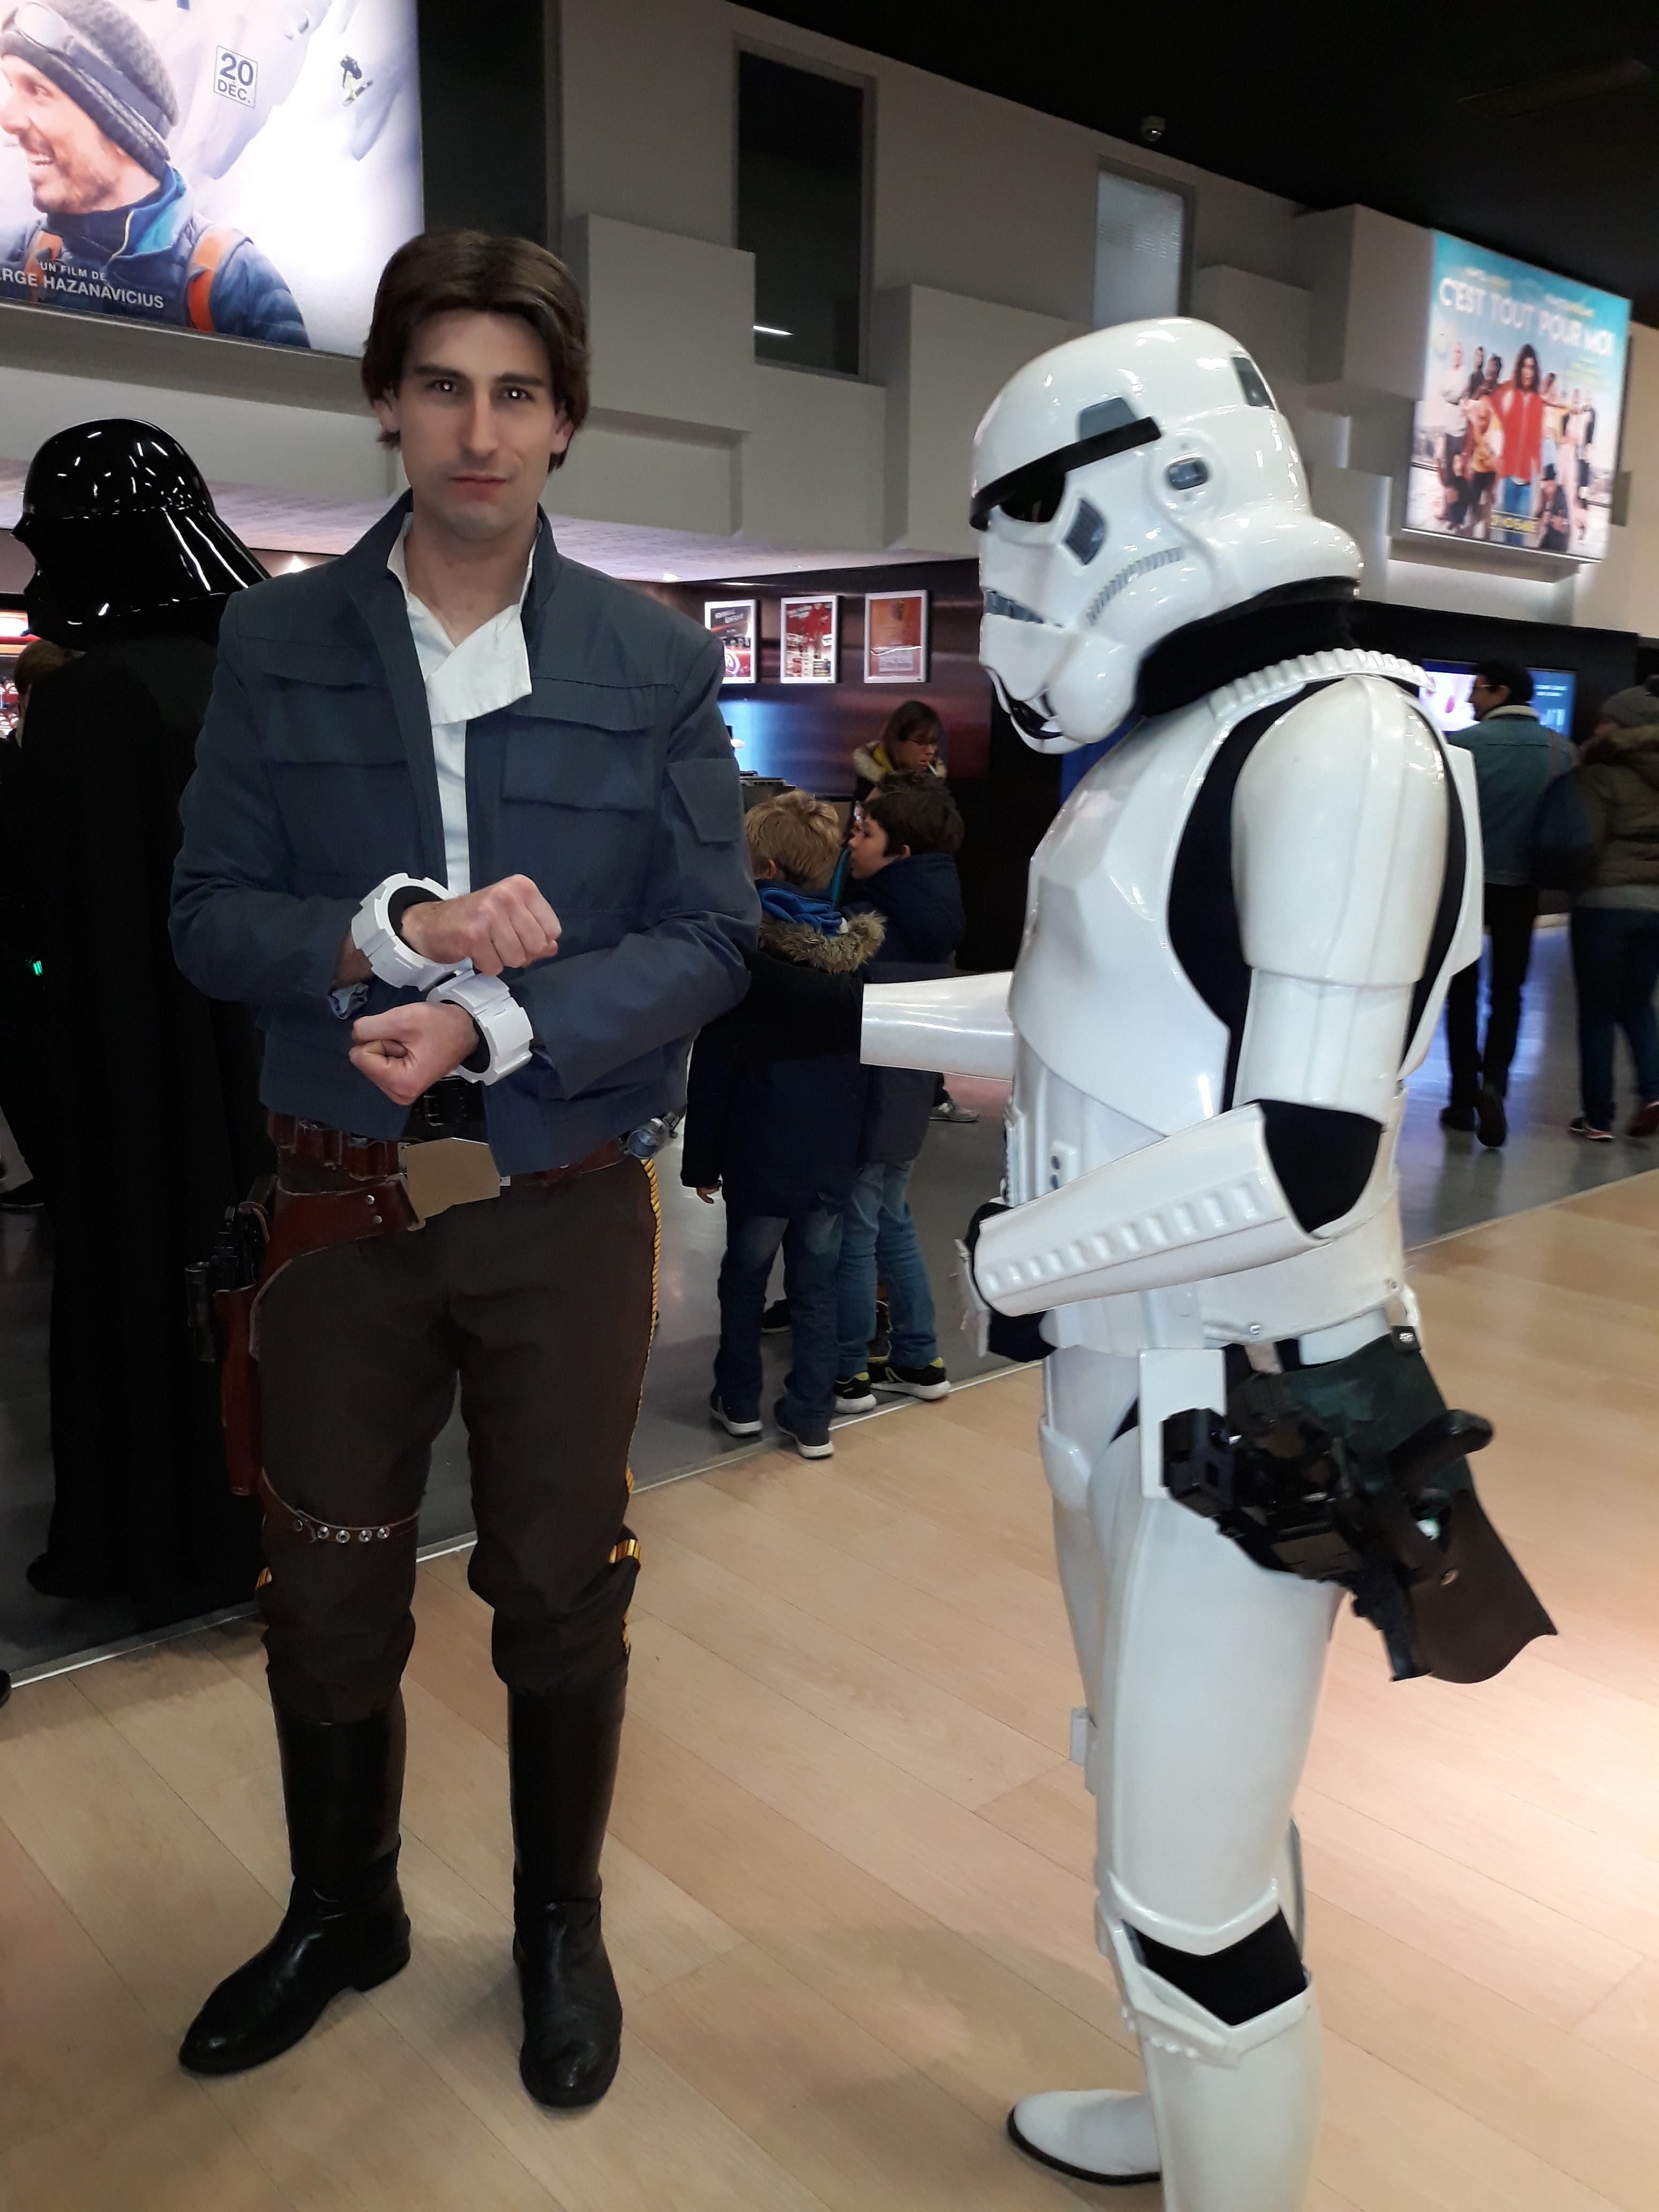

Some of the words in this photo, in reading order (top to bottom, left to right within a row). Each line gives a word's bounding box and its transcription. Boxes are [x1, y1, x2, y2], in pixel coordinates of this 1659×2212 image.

[219, 53, 253, 86] 20
[0, 267, 38, 288] RGE
[43, 275, 165, 309] HAZANAVICIUS
[40, 261, 56, 272] UN
[61, 265, 87, 278] FILM
[92, 271, 107, 281] DE
[1538, 310, 1582, 347] POUR
